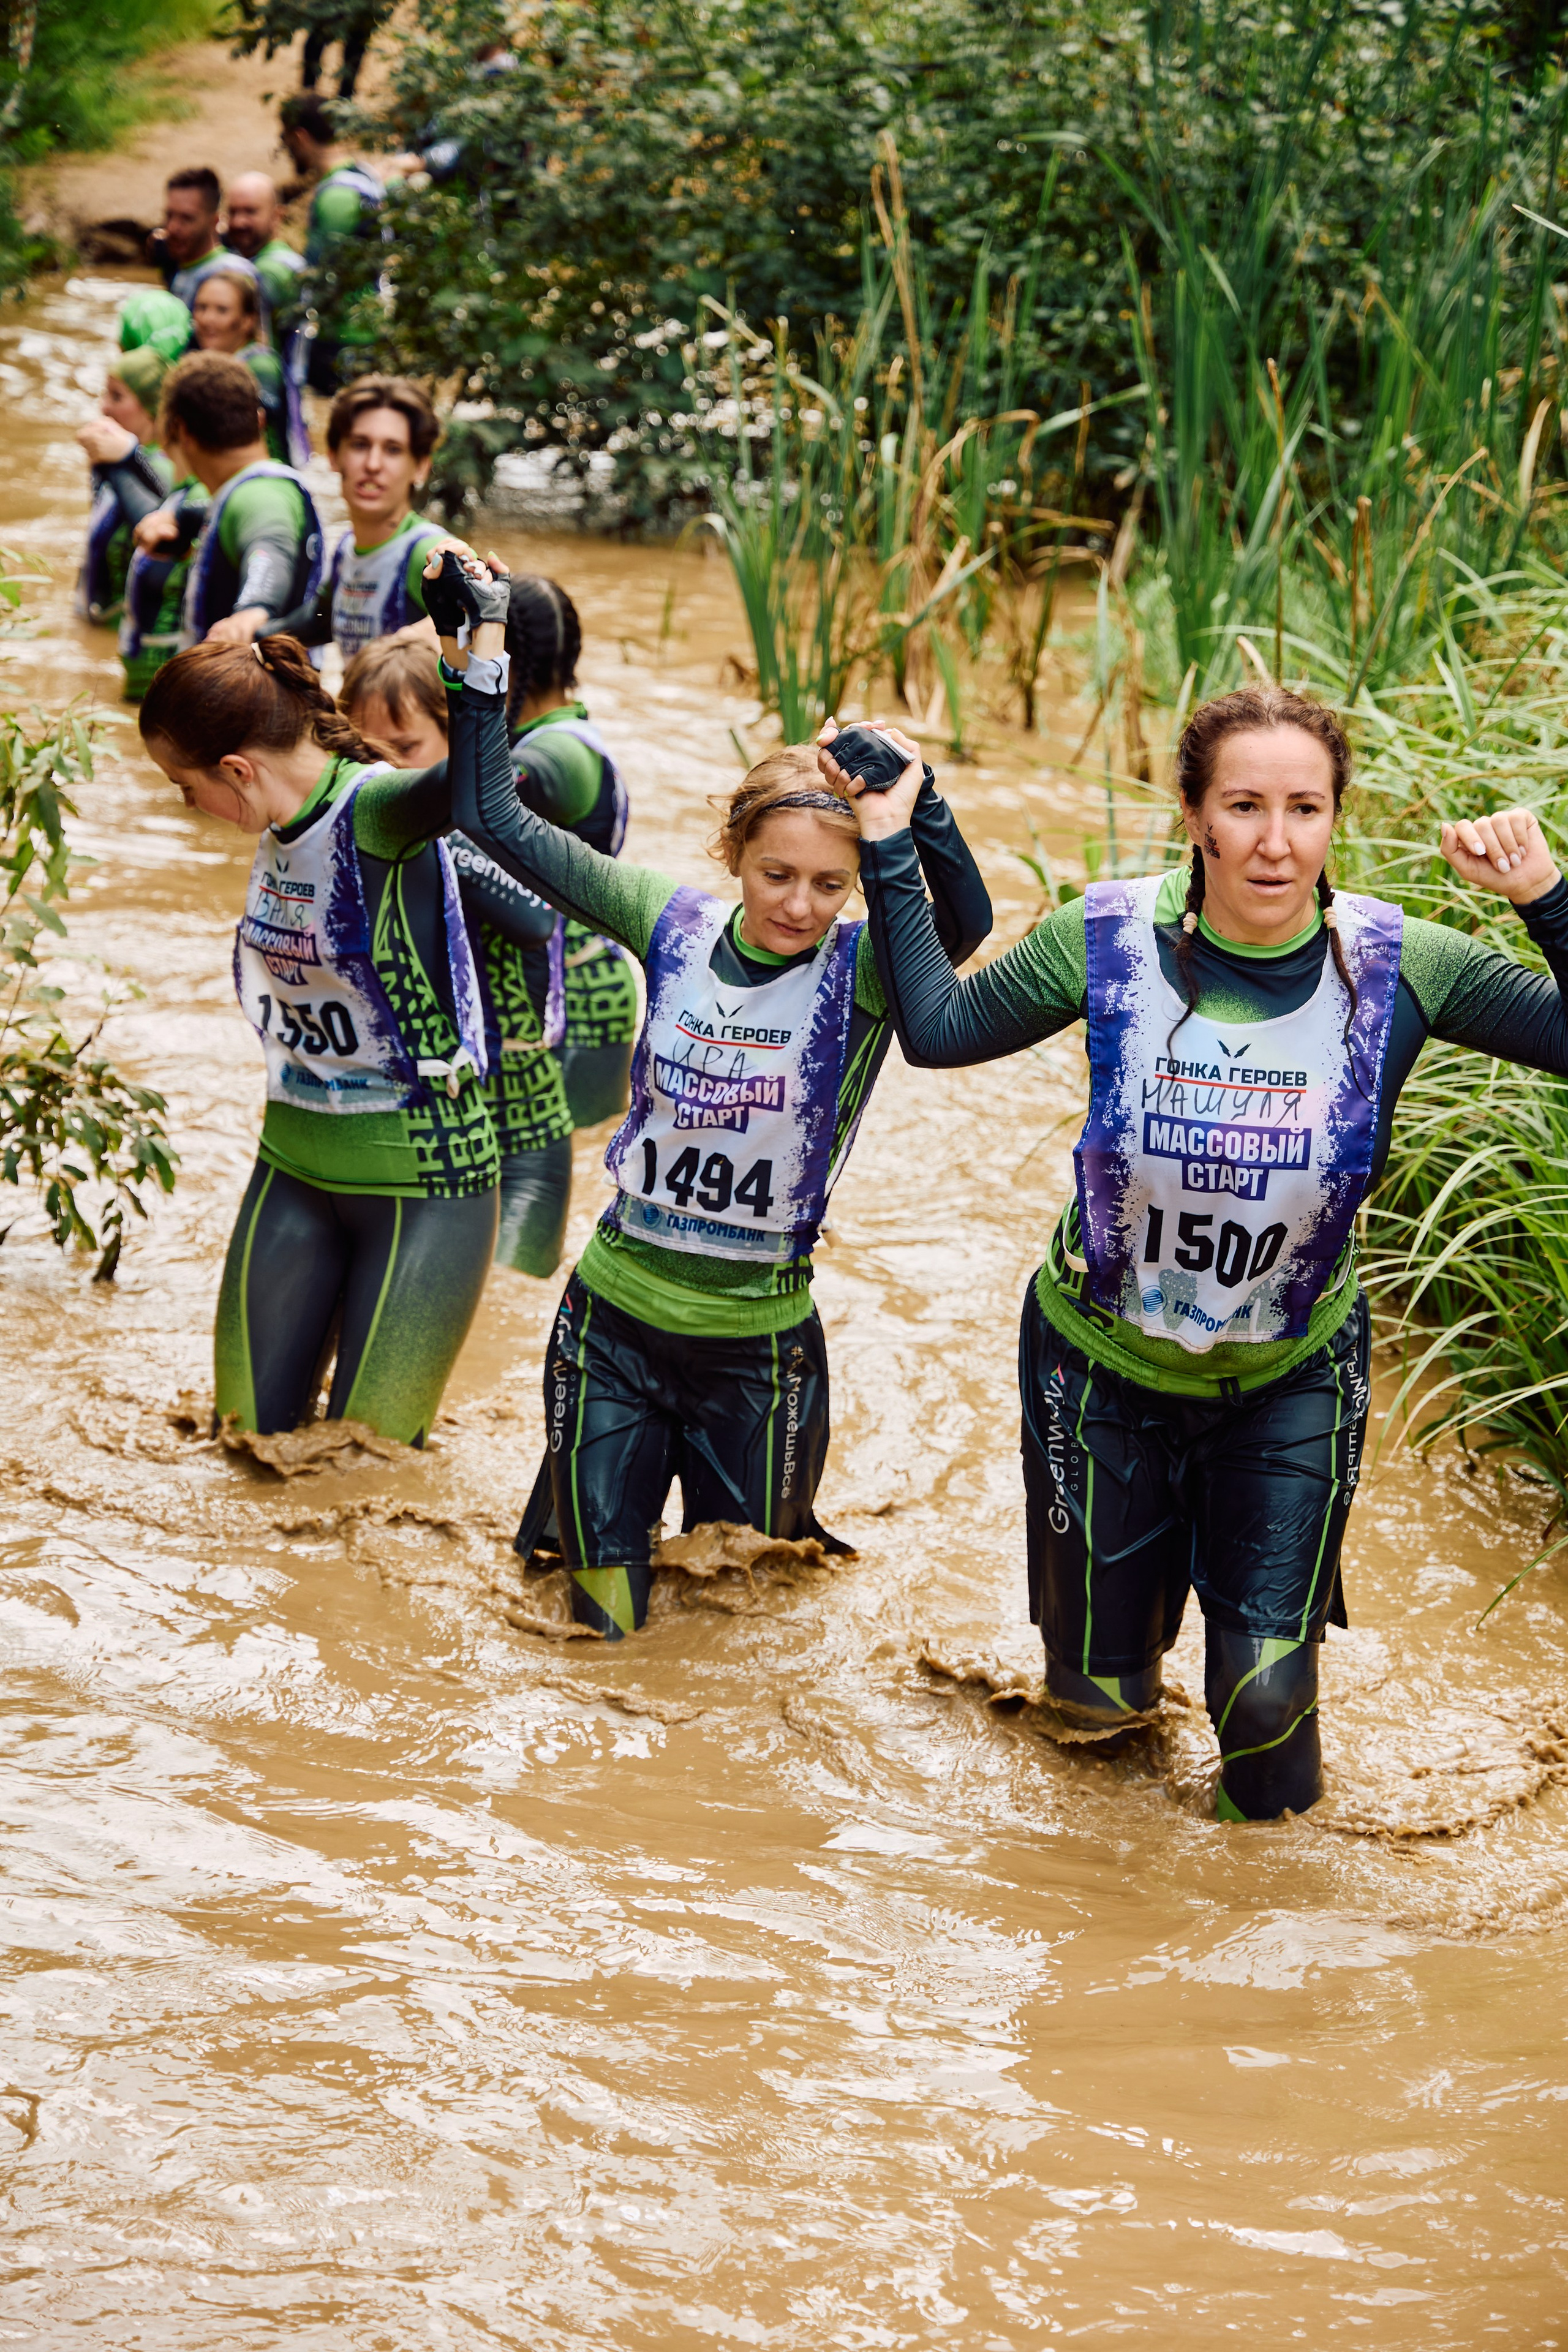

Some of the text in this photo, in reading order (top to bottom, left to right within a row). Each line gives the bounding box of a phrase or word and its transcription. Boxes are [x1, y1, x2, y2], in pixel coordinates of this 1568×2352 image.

[279, 881, 315, 897] ГЕРОЕВ
[258, 994, 359, 1057] 1550
[678, 1009, 792, 1044] ГОНКА ГЕРОЕВ
[673, 1035, 757, 1082] ИРА
[1155, 1057, 1307, 1087] ГОНКА ГЕРОЕВ
[655, 1061, 779, 1106] МАССОВЫЙ
[677, 1102, 745, 1129] СТАРТ
[1149, 1120, 1305, 1164] МАССОВЫЙ
[642, 1137, 774, 1217] 1494
[1187, 1162, 1264, 1197] СТАРТ
[666, 1214, 765, 1242] ГАЗПРОМБАНК
[1144, 1203, 1289, 1289] 1500
[1173, 1300, 1254, 1333] ГАЗПРОМНК
